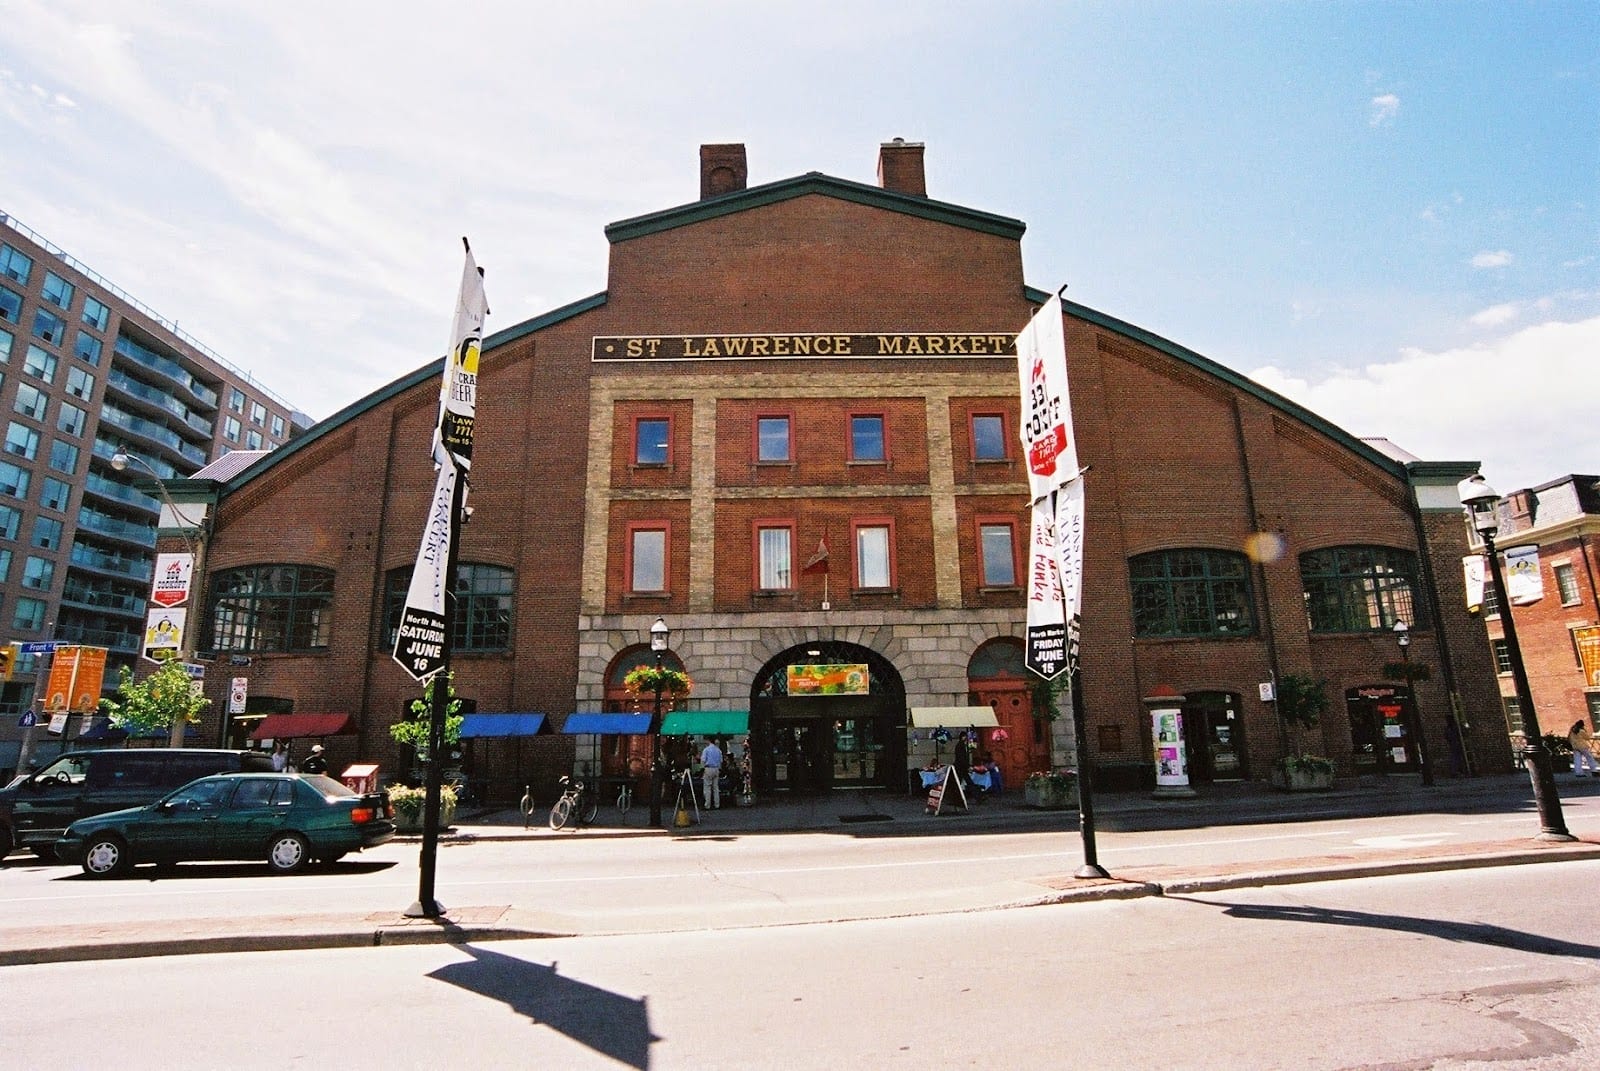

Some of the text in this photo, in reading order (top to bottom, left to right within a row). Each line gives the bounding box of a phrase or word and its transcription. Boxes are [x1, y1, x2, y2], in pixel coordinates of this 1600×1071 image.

[682, 336, 851, 358] LAWRENCE
[878, 336, 1007, 355] MARKET
[424, 487, 445, 565] CONCERT
[406, 614, 430, 626] North
[29, 643, 46, 651] Front
[406, 641, 442, 658] JUNE
[1033, 638, 1064, 650] FRIDAY
[1035, 650, 1064, 662] JUNE
[413, 658, 428, 671] 16
[1041, 662, 1055, 674] 15
